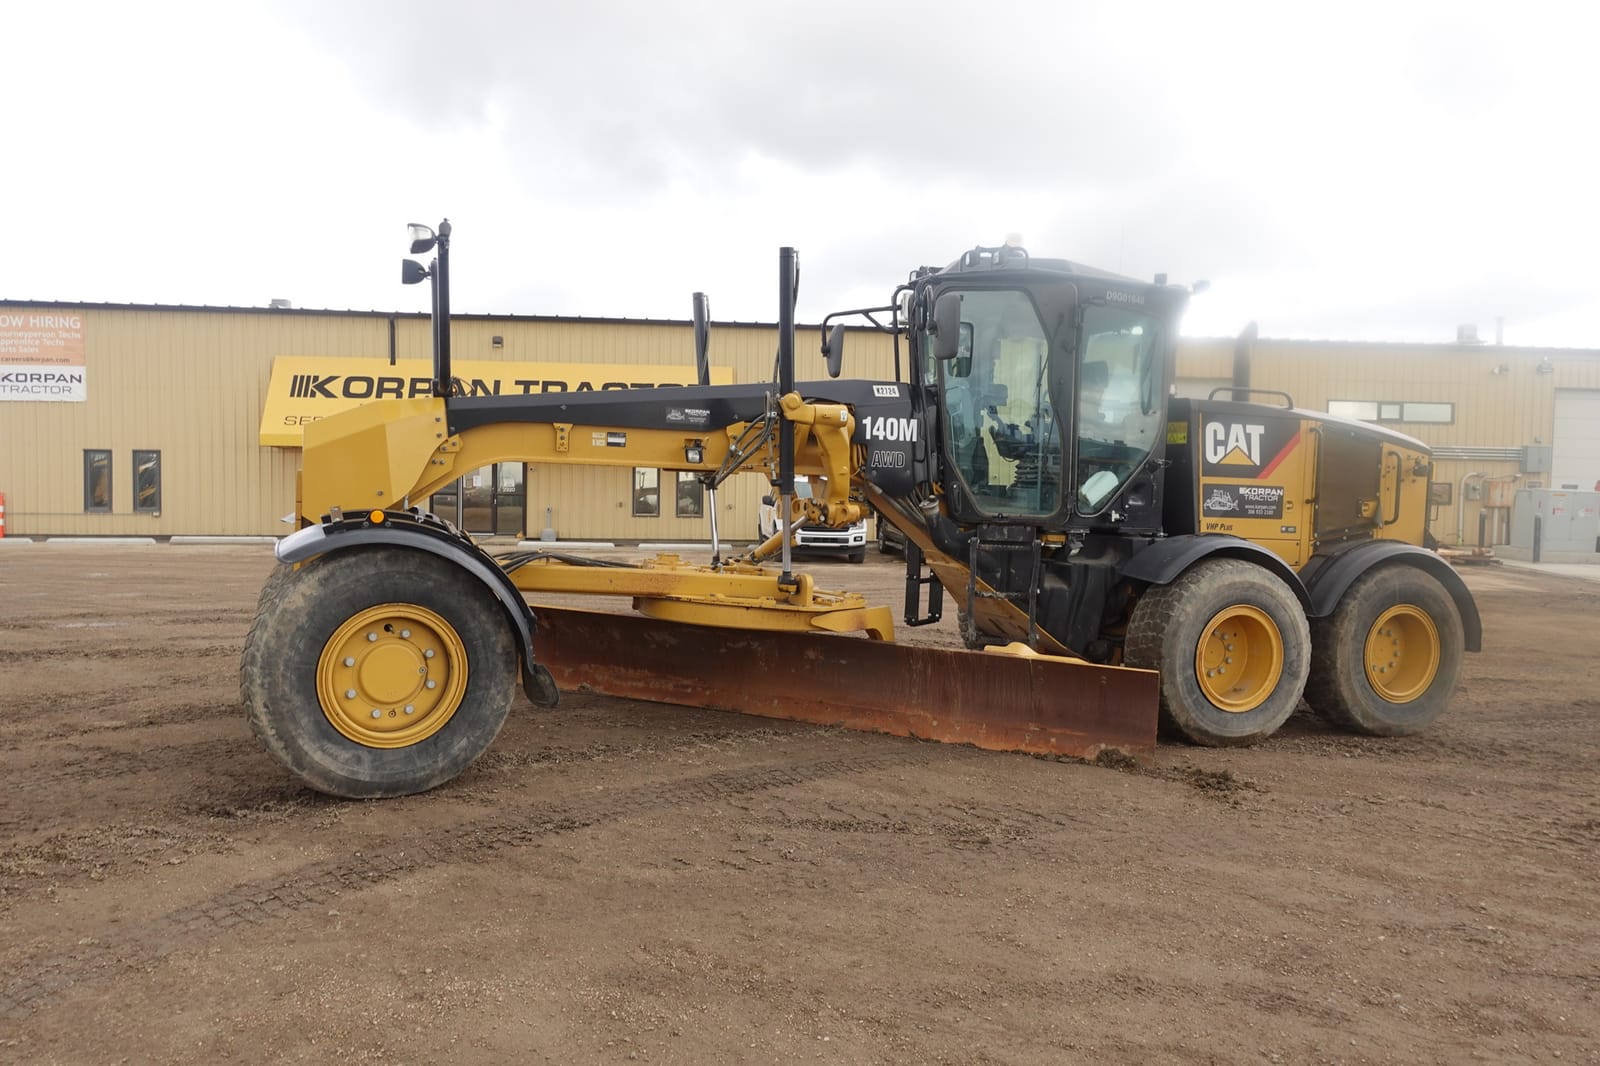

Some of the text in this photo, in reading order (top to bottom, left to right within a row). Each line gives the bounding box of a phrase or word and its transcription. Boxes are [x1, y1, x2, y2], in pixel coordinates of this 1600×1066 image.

[29, 315, 81, 329] HIRING
[1, 373, 82, 384] KORPAN
[0, 384, 72, 394] TRACTOR
[862, 416, 918, 442] 140M
[1205, 421, 1265, 466] CAT
[871, 450, 905, 468] AWD
[1240, 487, 1284, 496] KORPAN
[1244, 494, 1279, 502] TRACTOR
